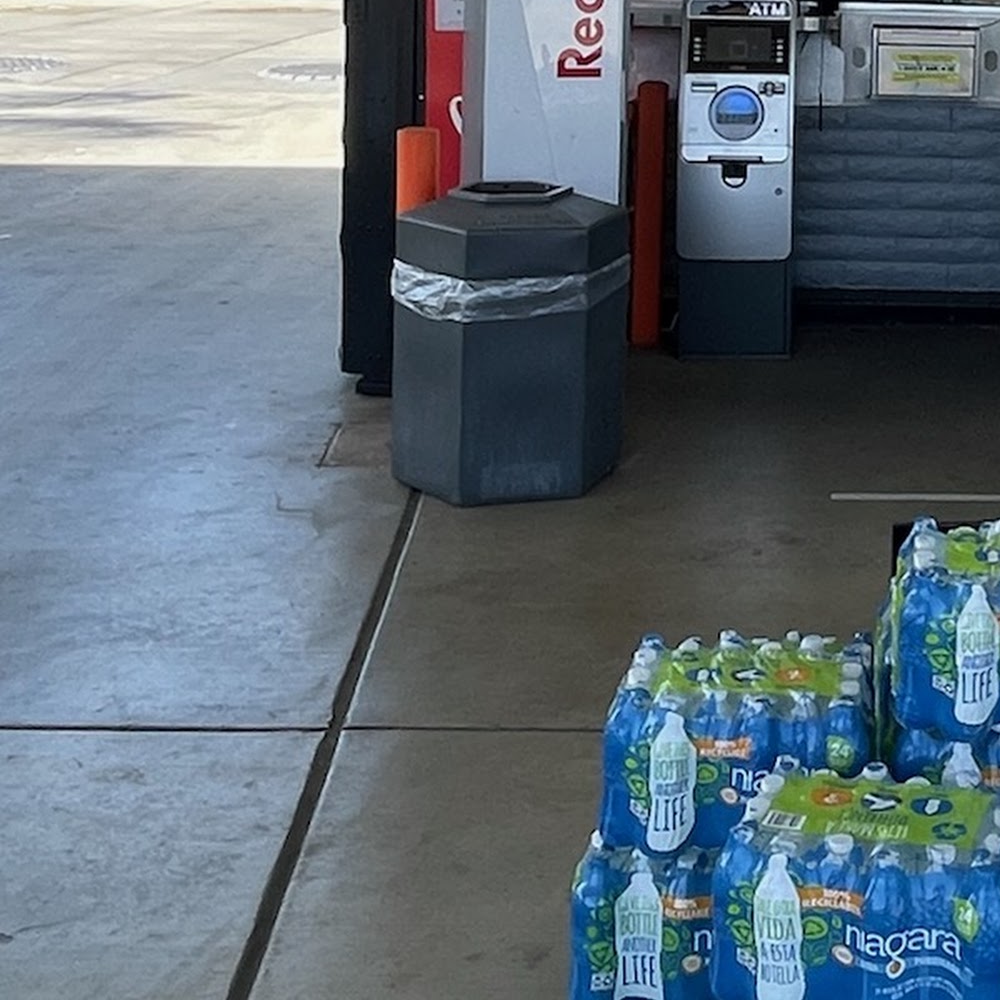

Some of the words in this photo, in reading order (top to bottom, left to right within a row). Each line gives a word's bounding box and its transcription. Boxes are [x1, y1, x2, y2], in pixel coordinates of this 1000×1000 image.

[749, 2, 786, 16] ATM
[962, 667, 993, 704] LIFE
[654, 794, 689, 832] LIFE
[757, 917, 797, 941] VIDA
[845, 923, 962, 980] niagara
[622, 954, 658, 989] LIFE
